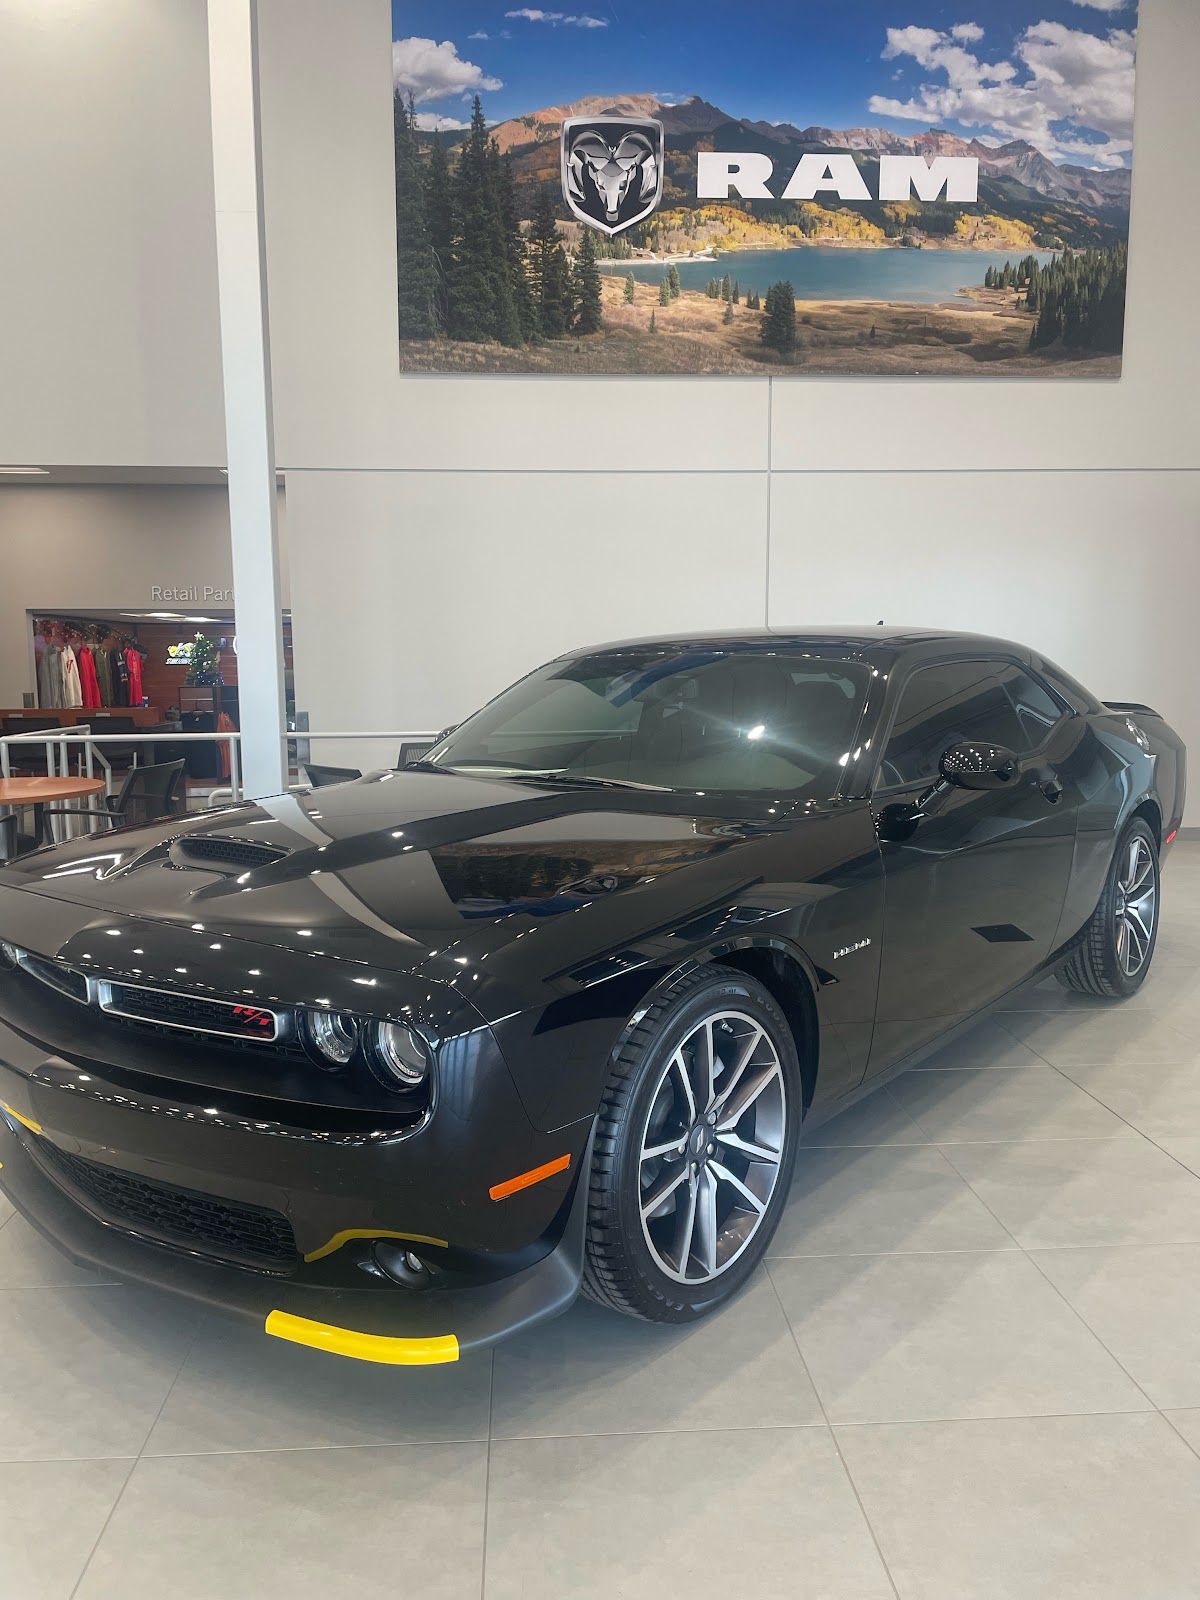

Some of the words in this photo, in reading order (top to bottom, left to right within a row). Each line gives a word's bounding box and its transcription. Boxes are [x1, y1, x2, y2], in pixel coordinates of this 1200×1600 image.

[697, 151, 979, 203] RAM
[151, 585, 198, 601] Retail
[233, 1005, 274, 1025] R/T
